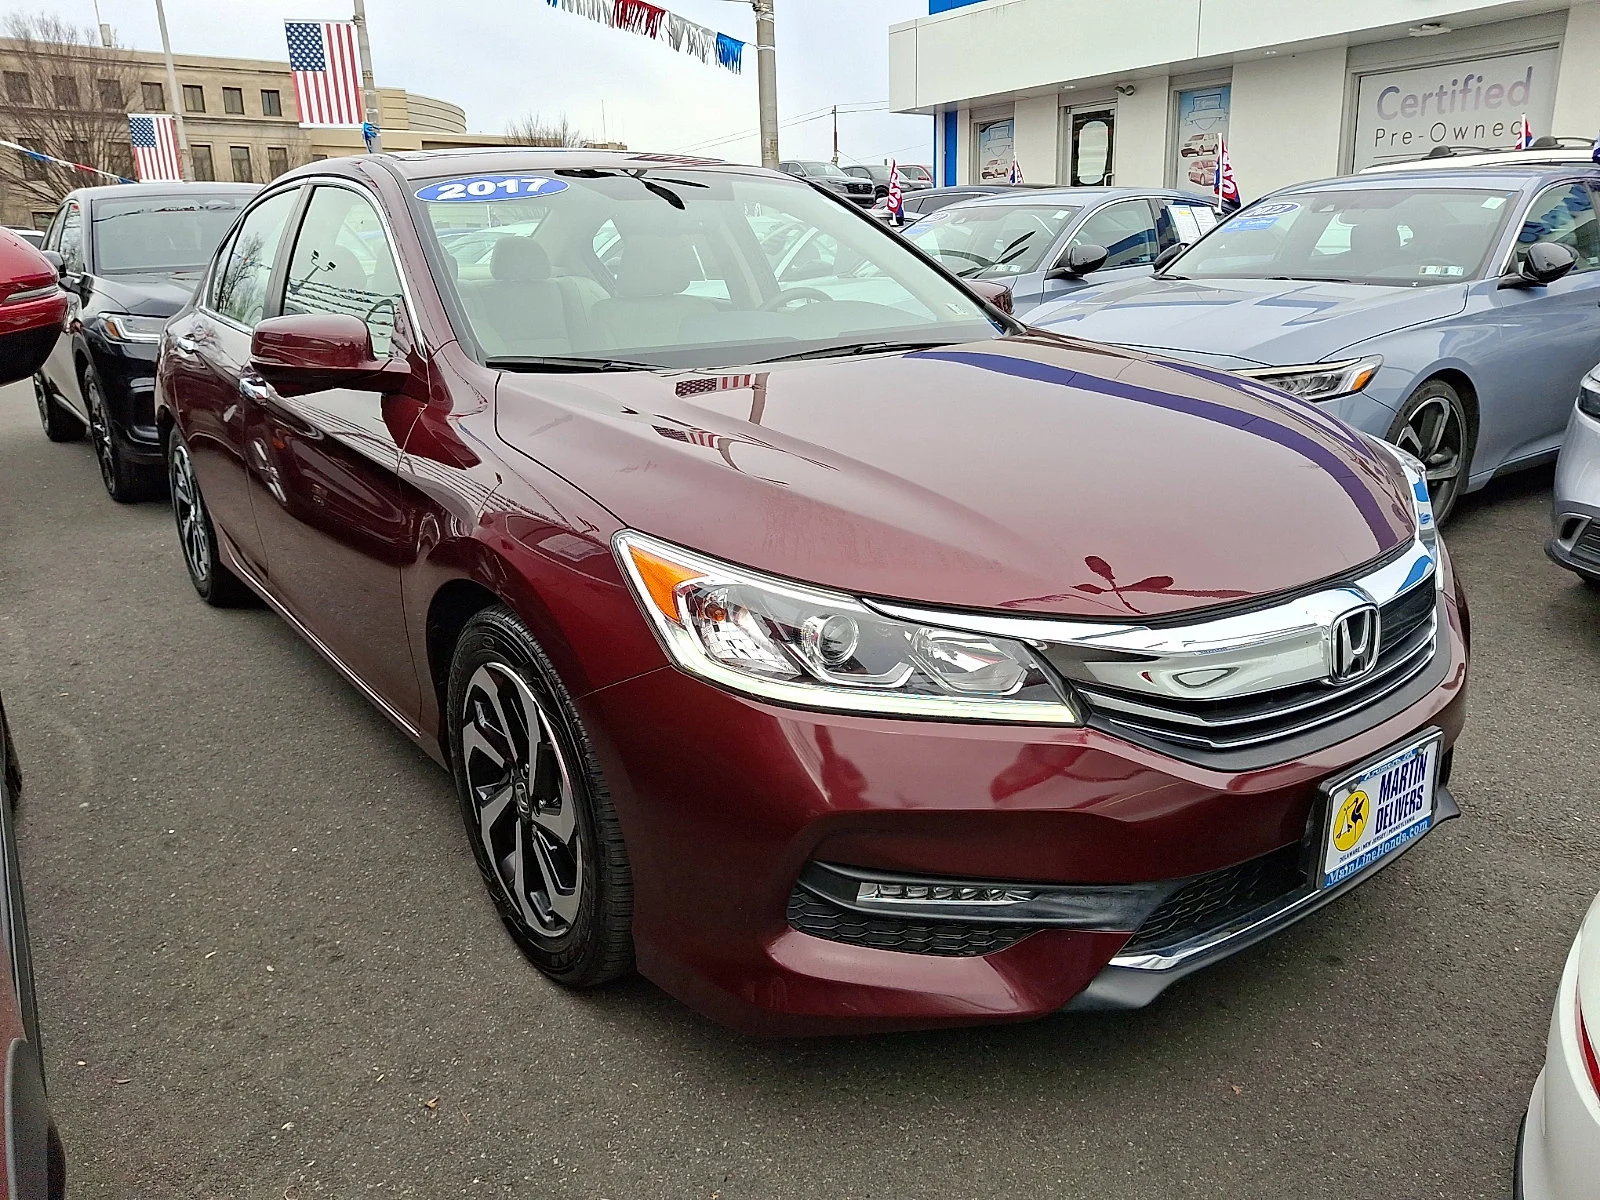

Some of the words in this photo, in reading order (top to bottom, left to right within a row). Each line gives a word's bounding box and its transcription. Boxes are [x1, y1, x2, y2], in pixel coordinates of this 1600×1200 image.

[1376, 65, 1533, 120] Certified
[436, 178, 549, 200] 2017
[1378, 751, 1428, 805] MARTIN
[1375, 784, 1424, 835] DELIVERS
